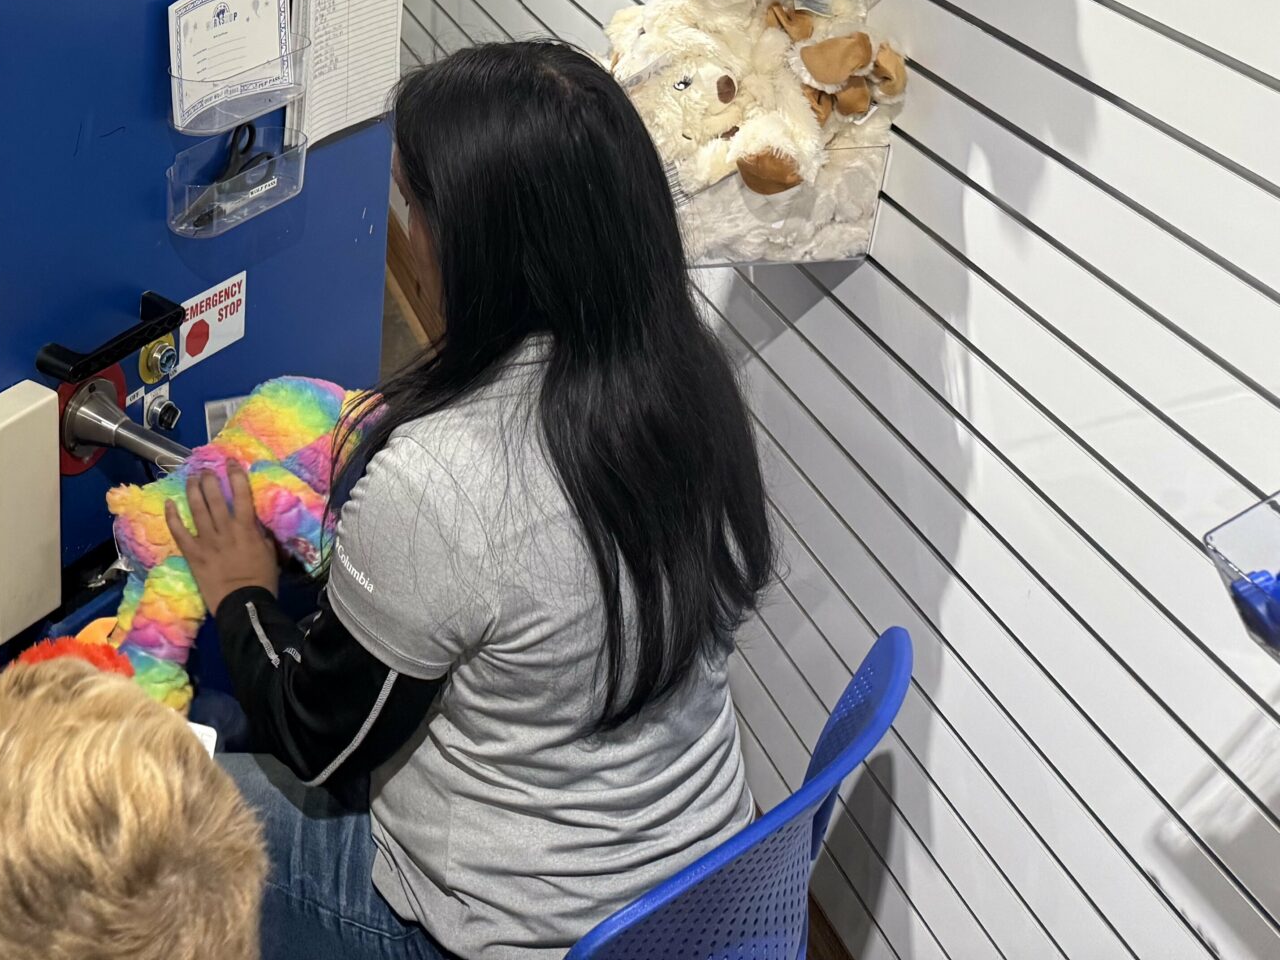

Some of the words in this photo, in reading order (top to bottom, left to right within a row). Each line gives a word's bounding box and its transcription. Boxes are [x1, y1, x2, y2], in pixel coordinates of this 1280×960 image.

[184, 279, 243, 322] EMERGENCY
[217, 298, 242, 322] STOP
[337, 544, 374, 593] Columbia
